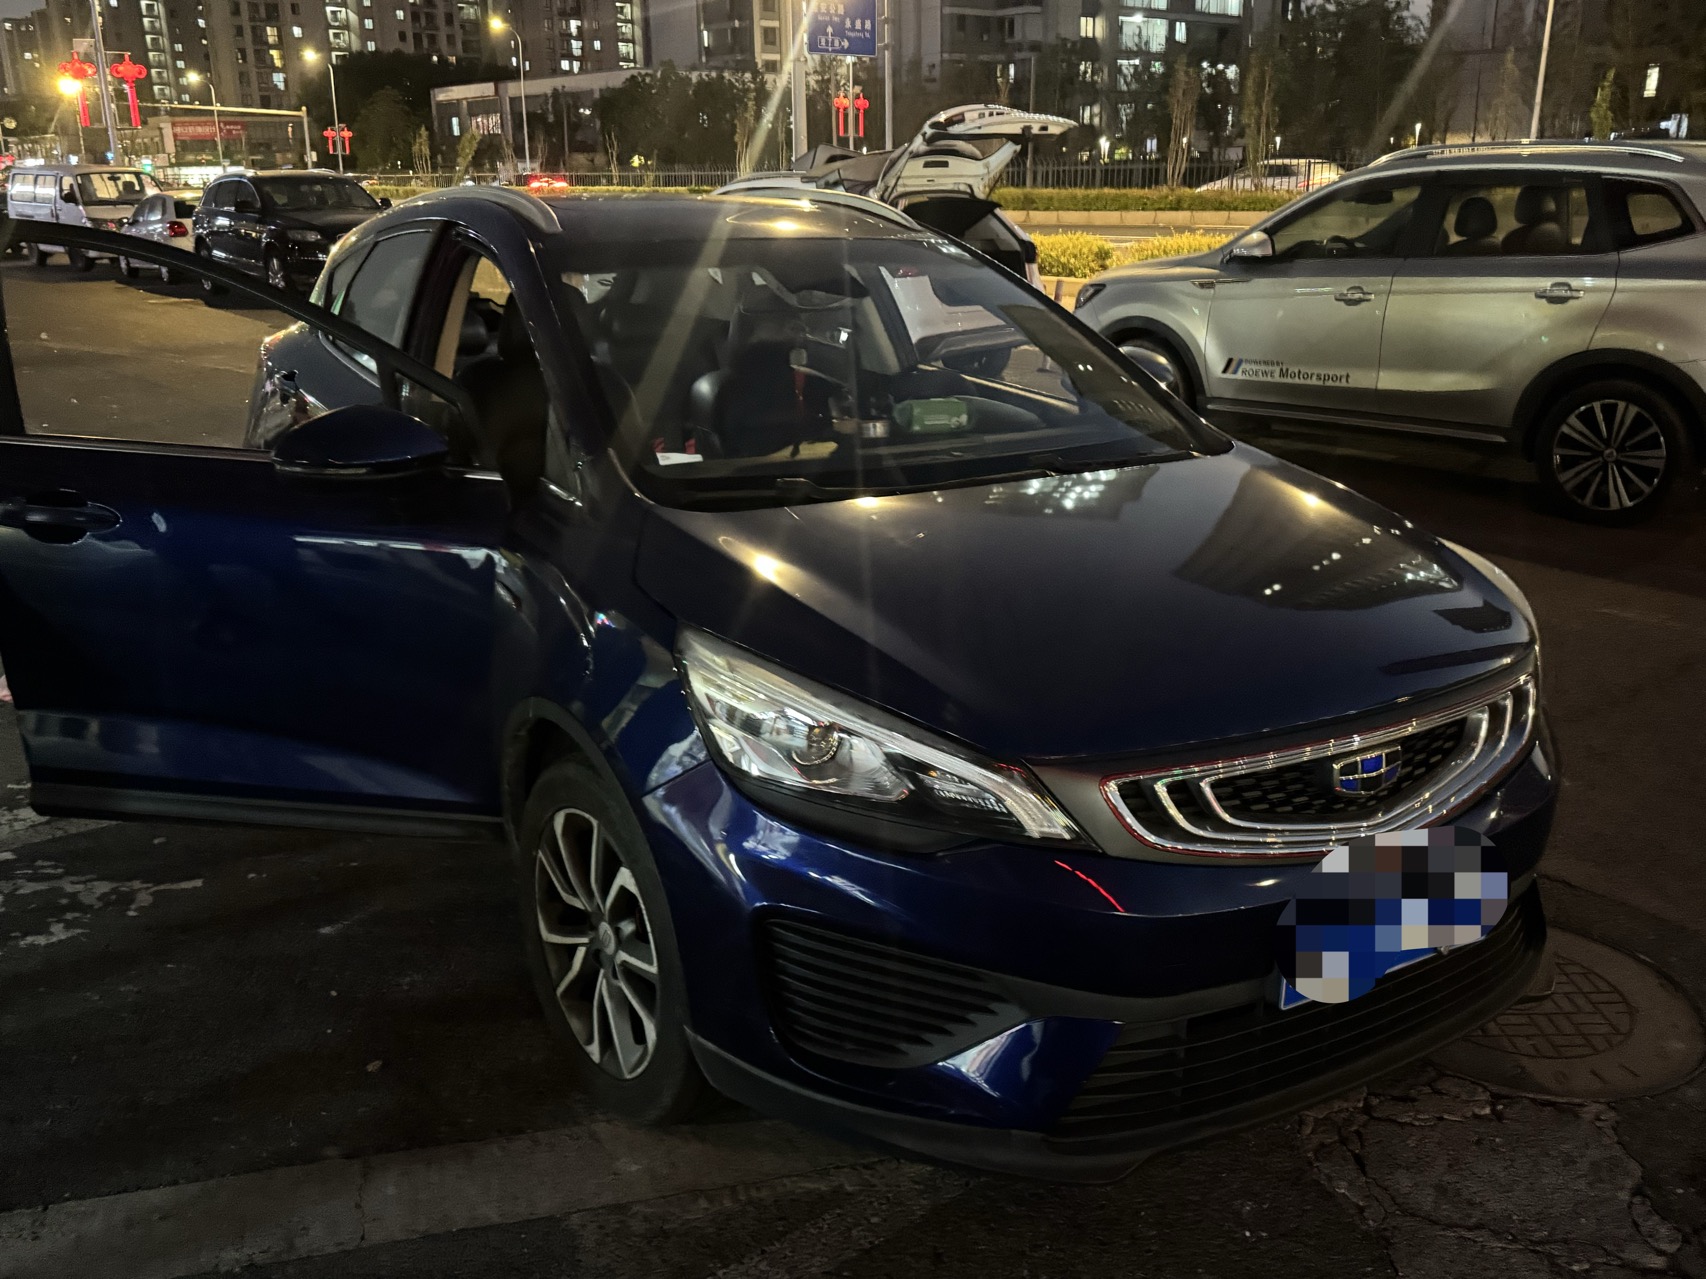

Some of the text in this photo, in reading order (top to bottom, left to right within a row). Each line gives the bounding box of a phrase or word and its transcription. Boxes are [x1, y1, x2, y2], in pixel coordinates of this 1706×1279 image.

[1244, 359, 1275, 367] POWERED
[1241, 367, 1351, 385] ROEWE Motorsport
